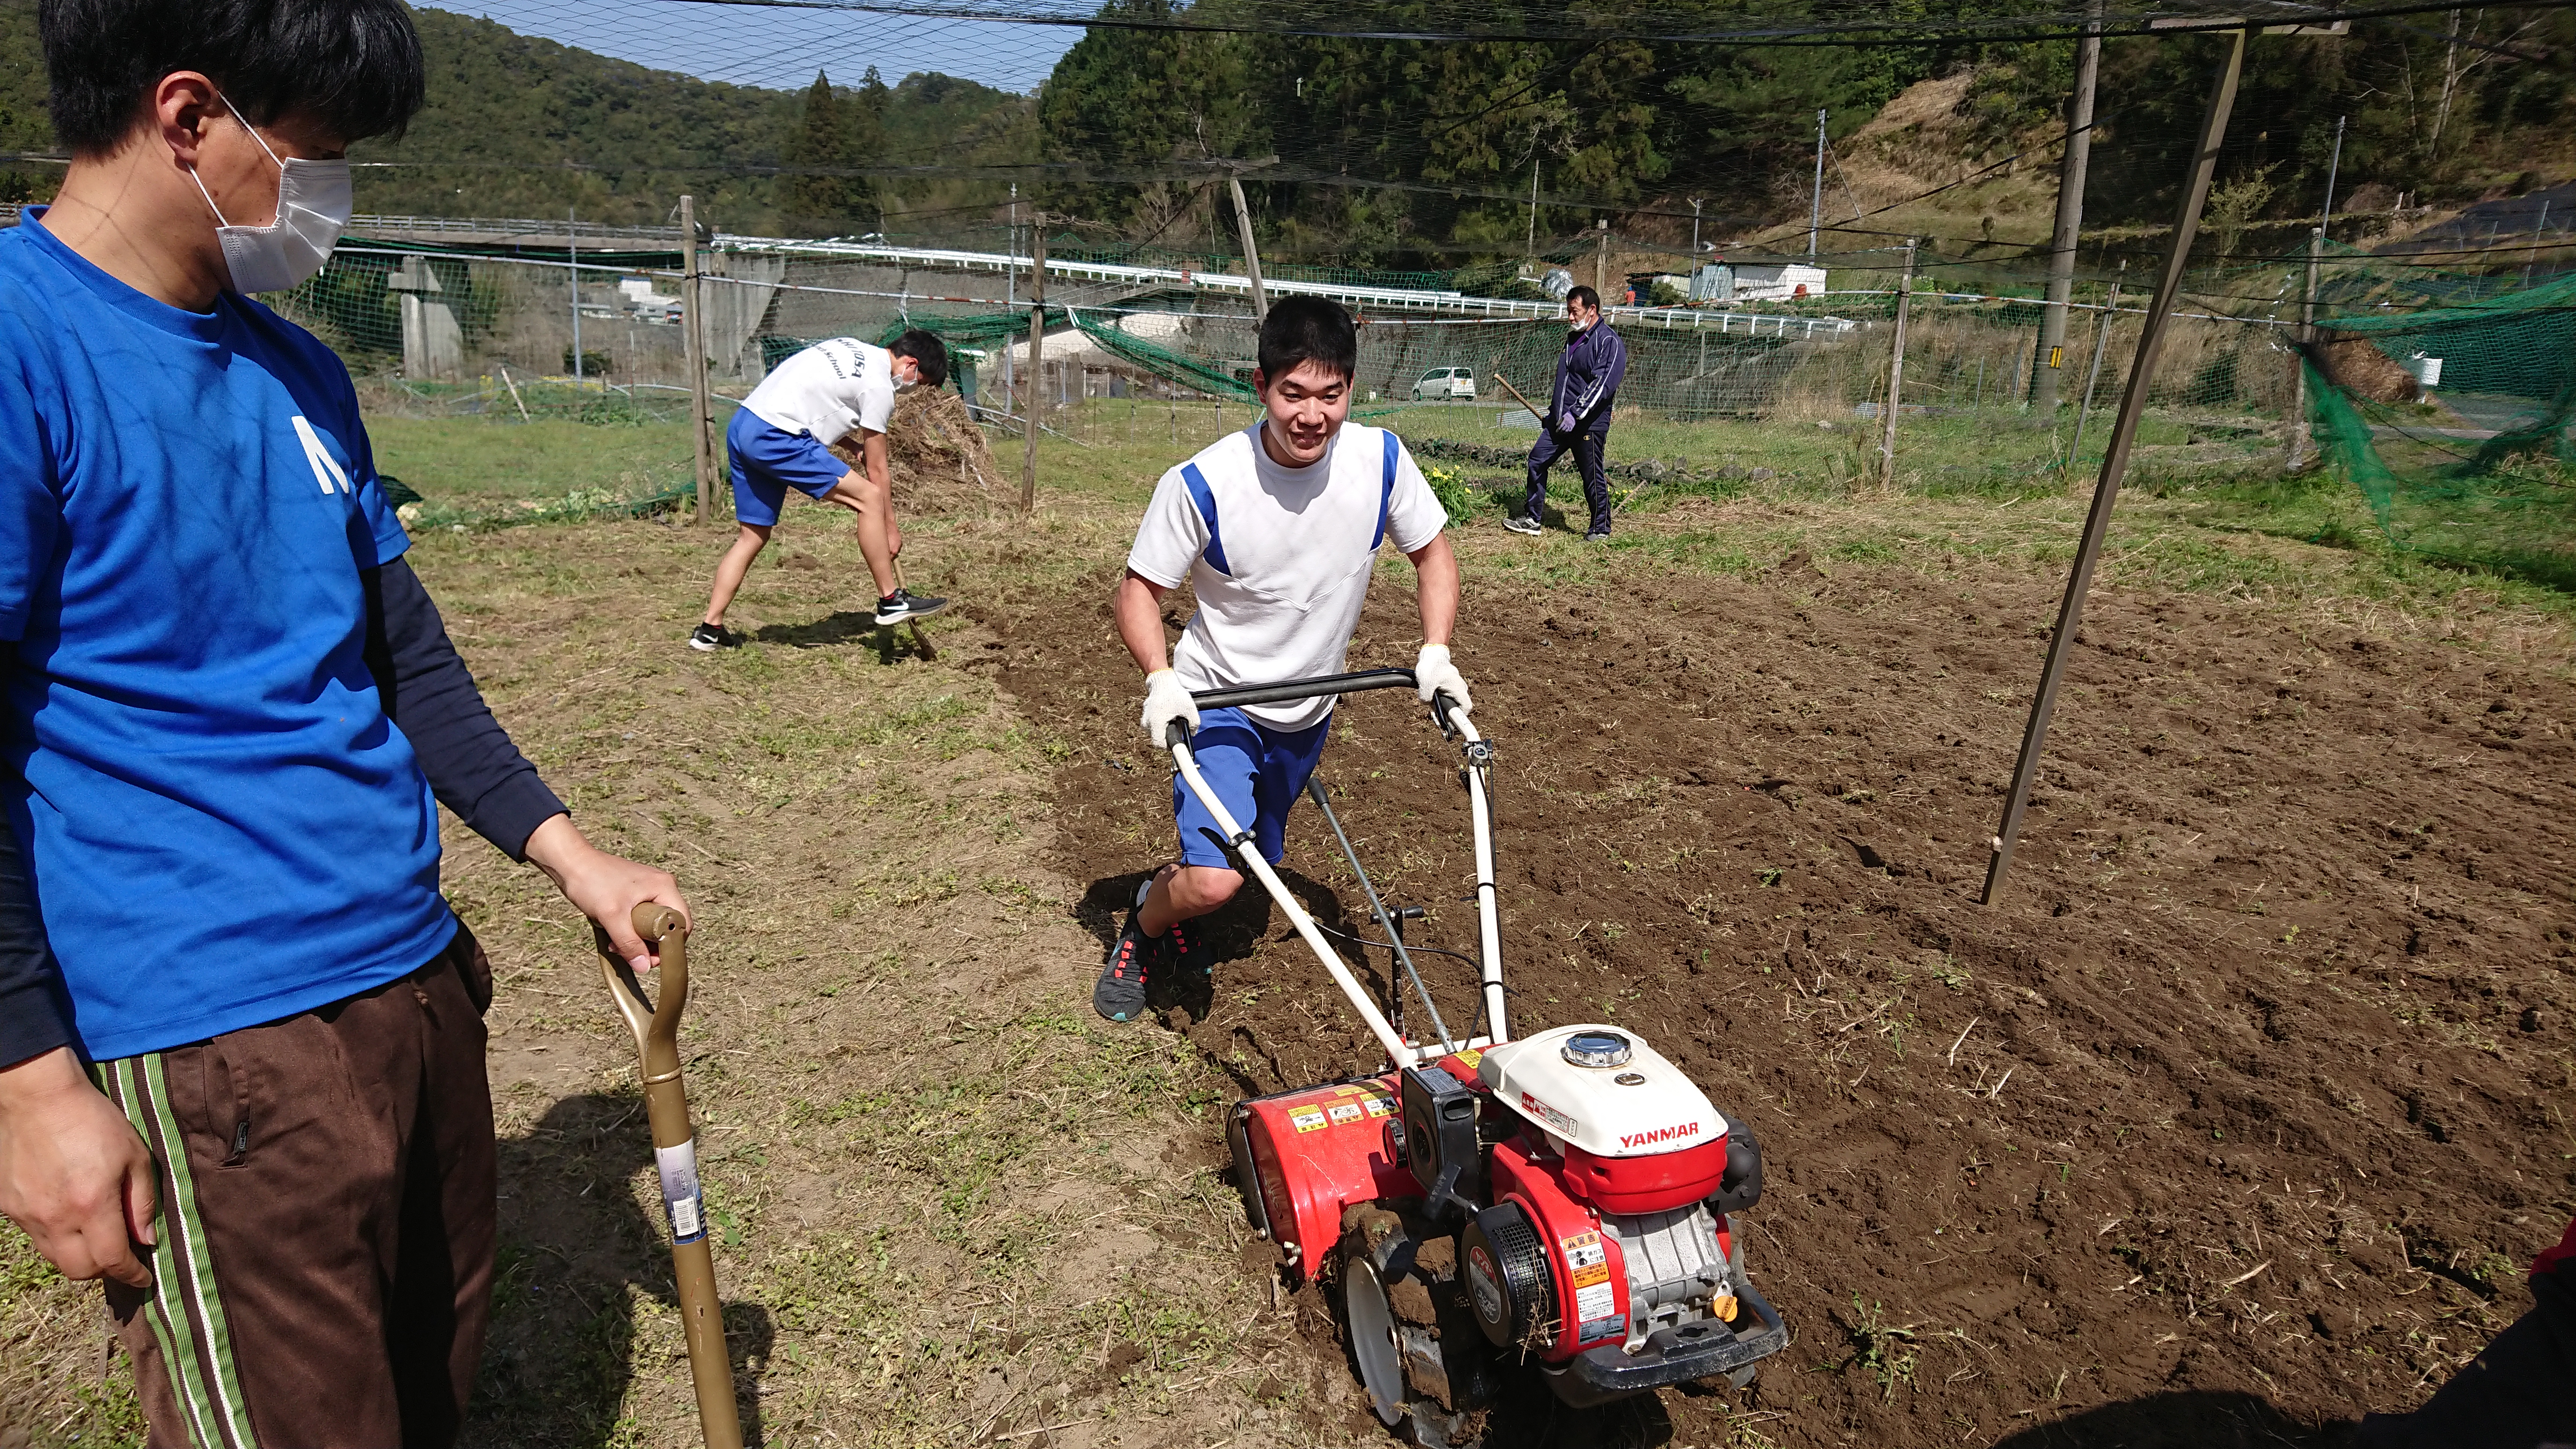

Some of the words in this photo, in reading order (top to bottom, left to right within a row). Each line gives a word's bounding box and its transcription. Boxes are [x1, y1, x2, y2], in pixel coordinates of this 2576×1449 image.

[824, 352, 847, 379] School
[1619, 1122, 1698, 1148] YANMAR
[1577, 1234, 1595, 1245] 警告
[1475, 1251, 1492, 1273] ヤンマー
[1589, 1255, 1604, 1263] に注意
